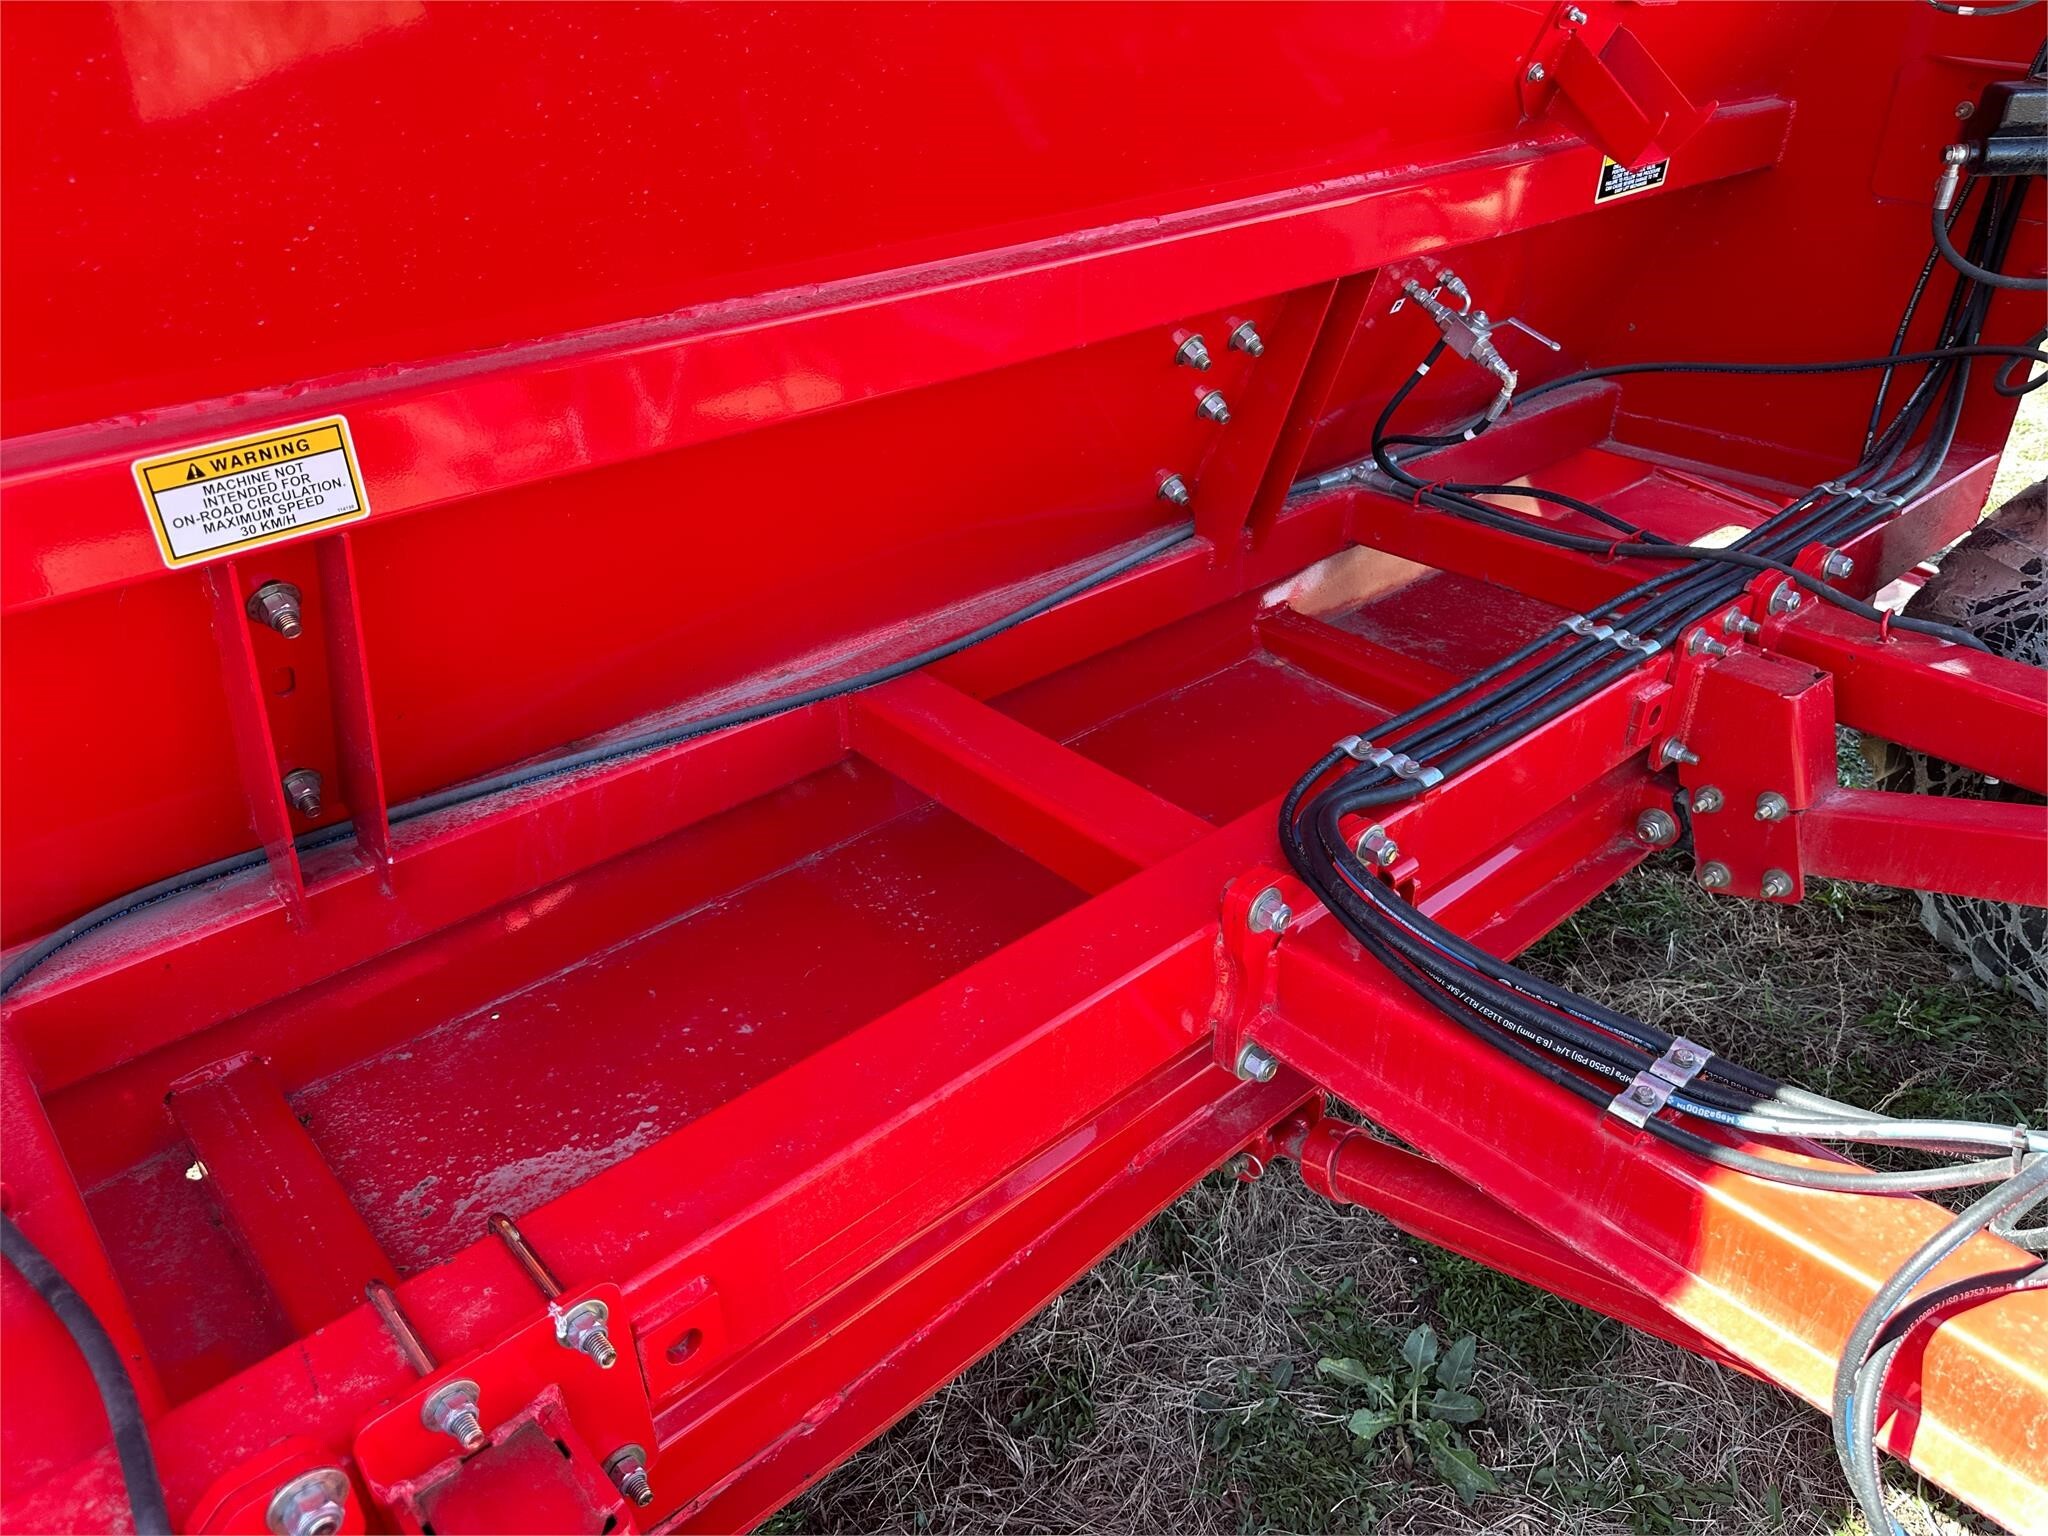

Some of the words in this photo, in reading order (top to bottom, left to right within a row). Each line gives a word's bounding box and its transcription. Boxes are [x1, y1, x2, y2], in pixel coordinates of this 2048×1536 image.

[210, 438, 310, 472] WARNING
[202, 470, 272, 496] MACHINE
[274, 462, 304, 478] NOT
[203, 481, 277, 509] INTENDED
[281, 473, 311, 491] FOR
[172, 503, 243, 529] ON-ROAD
[247, 477, 346, 510] CIRCULATION.
[203, 507, 275, 534] MAXIMUM
[278, 493, 325, 514] SPEED
[240, 525, 257, 537] 30
[261, 514, 297, 532] KM/H
[1463, 996, 1479, 1009] R17
[1478, 1006, 1503, 1023] 11237
[1502, 1019, 1517, 1031] ISO
[1517, 1024, 1536, 1040] mm)
[1535, 1035, 1553, 1049] (6.3
[1571, 1050, 1589, 1065] PSI)
[1589, 1060, 1615, 1077] (3250
[1945, 1294, 1959, 1306] ISO
